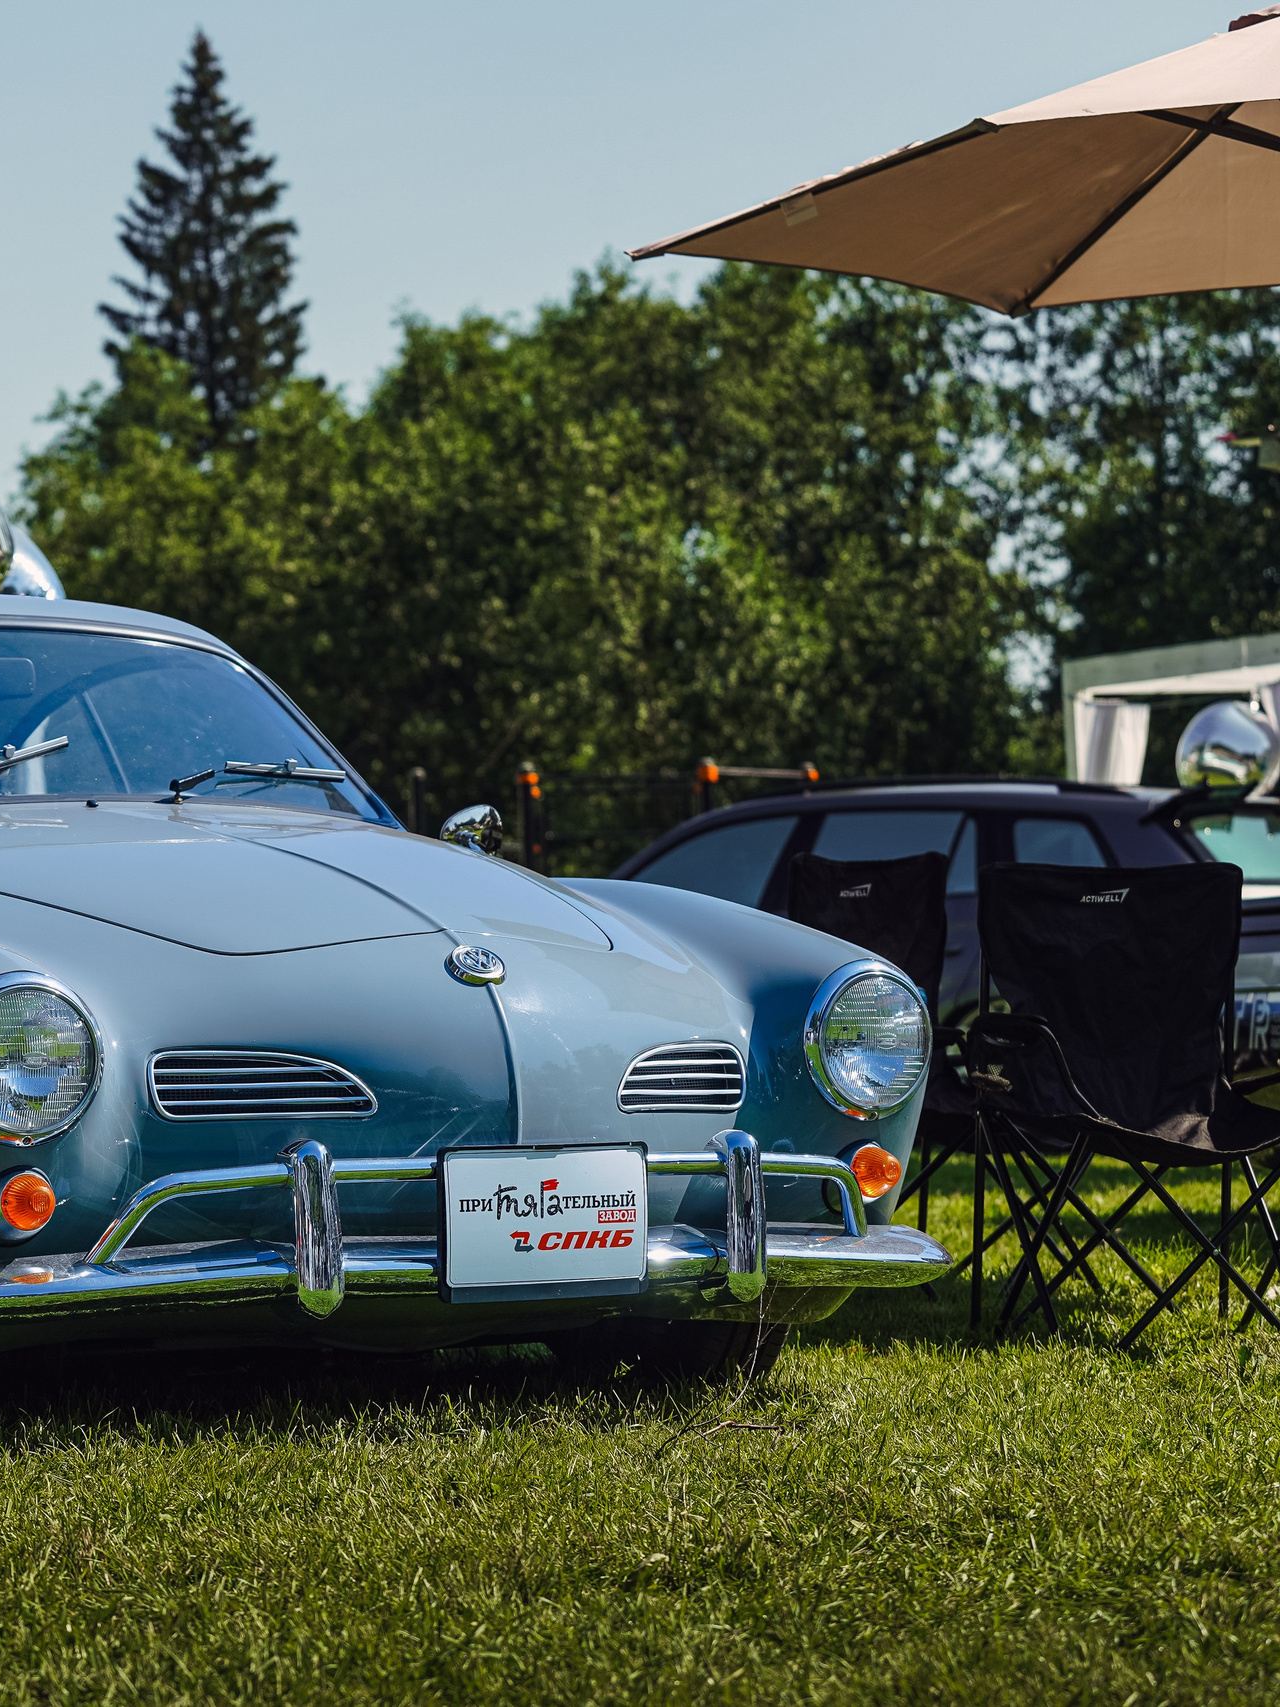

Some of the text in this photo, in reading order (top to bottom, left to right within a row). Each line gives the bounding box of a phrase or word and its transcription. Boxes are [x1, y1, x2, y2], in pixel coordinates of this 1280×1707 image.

[1079, 893, 1122, 903] ACTIWELL
[598, 1210, 636, 1222] ЗАВОД
[537, 1229, 635, 1251] СПКБ
